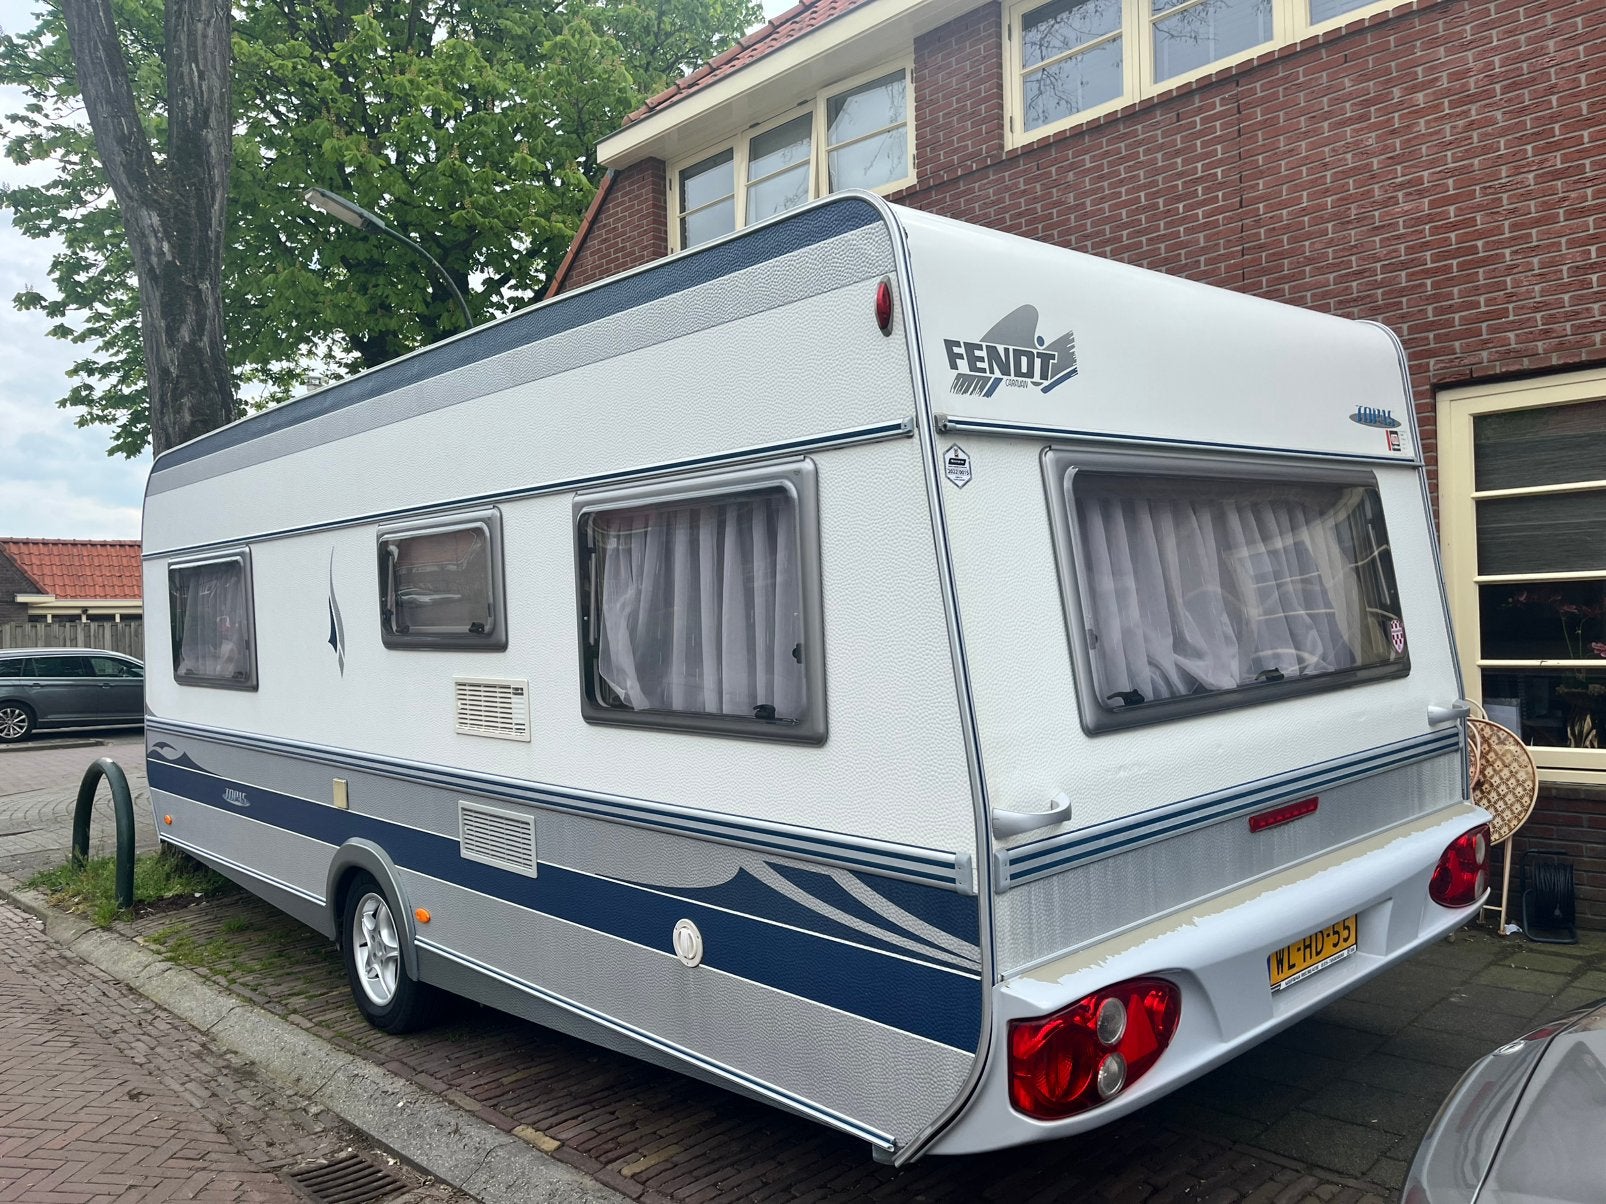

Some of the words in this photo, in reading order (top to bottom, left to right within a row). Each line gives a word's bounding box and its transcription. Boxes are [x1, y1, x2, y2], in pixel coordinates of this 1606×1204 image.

[943, 338, 1056, 381] FENDT
[1005, 378, 1029, 389] CARAVAN
[1275, 916, 1351, 976] WL-HD-55
